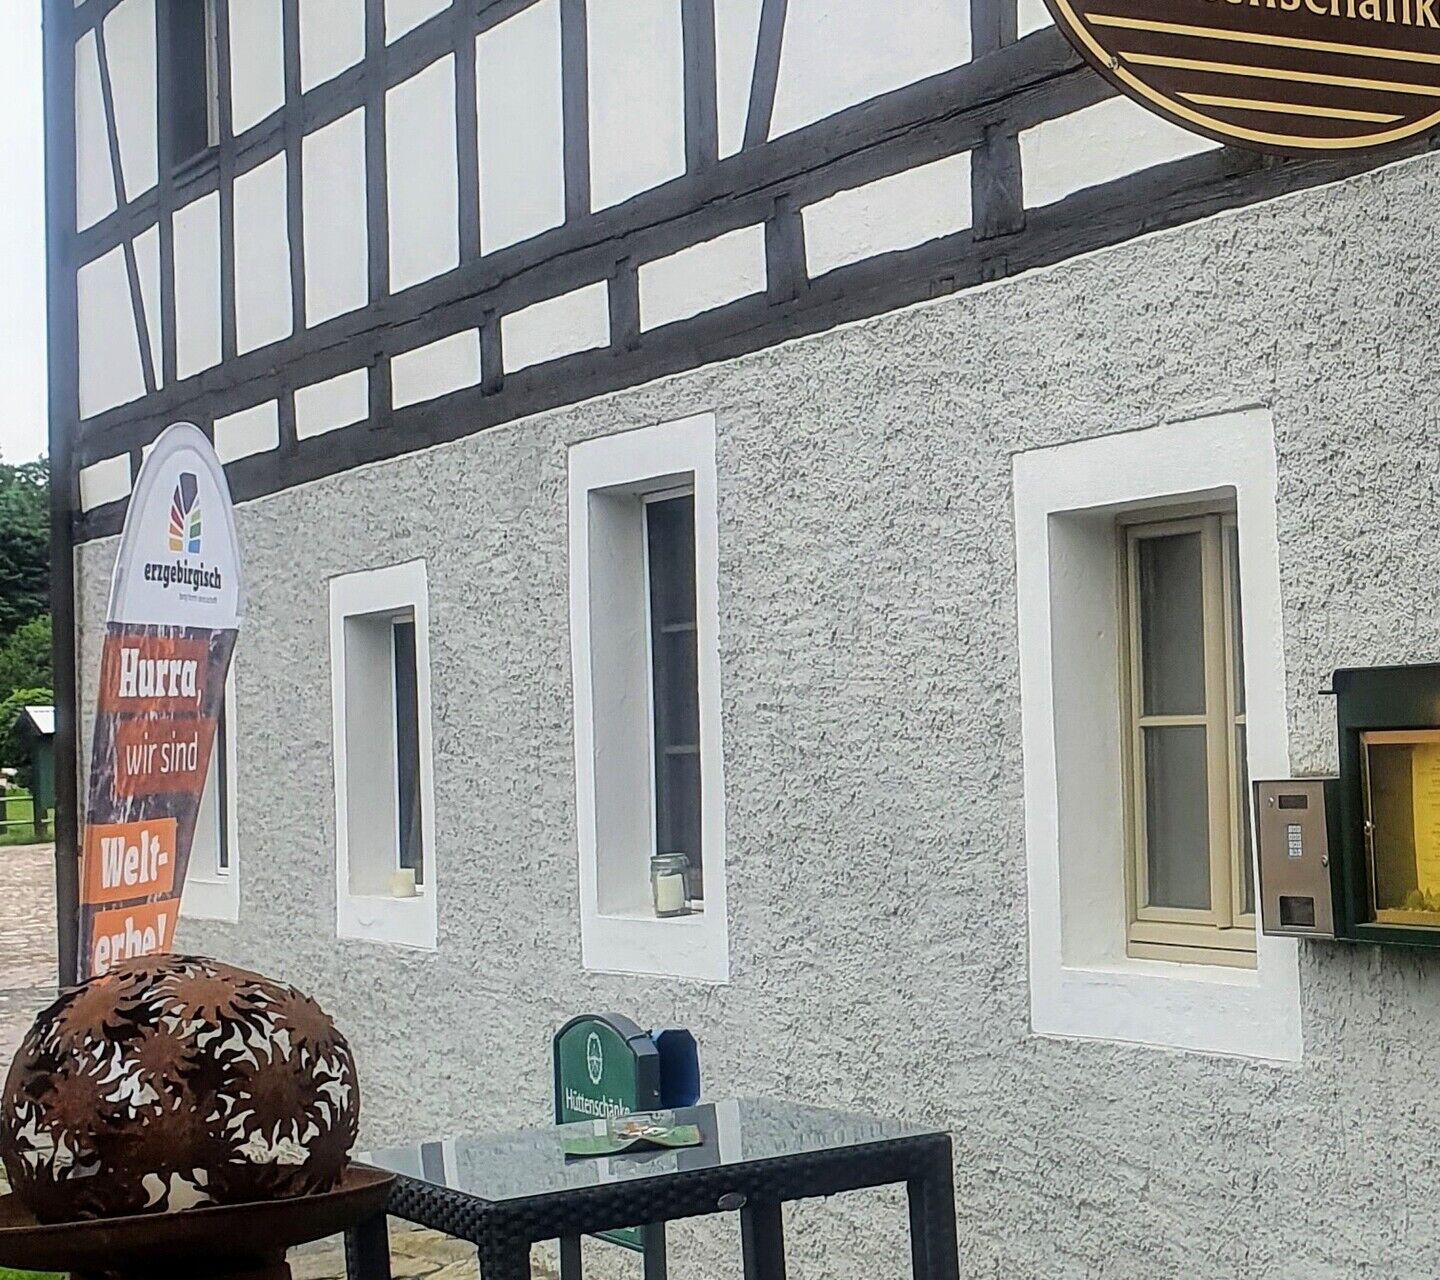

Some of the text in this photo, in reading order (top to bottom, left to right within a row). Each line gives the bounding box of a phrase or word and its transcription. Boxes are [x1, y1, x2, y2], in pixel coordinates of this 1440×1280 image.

[144, 558, 222, 592] erzgebirgisch
[118, 648, 202, 707] Hurra,
[124, 731, 198, 776] wir sind
[100, 828, 169, 890] Welt-
